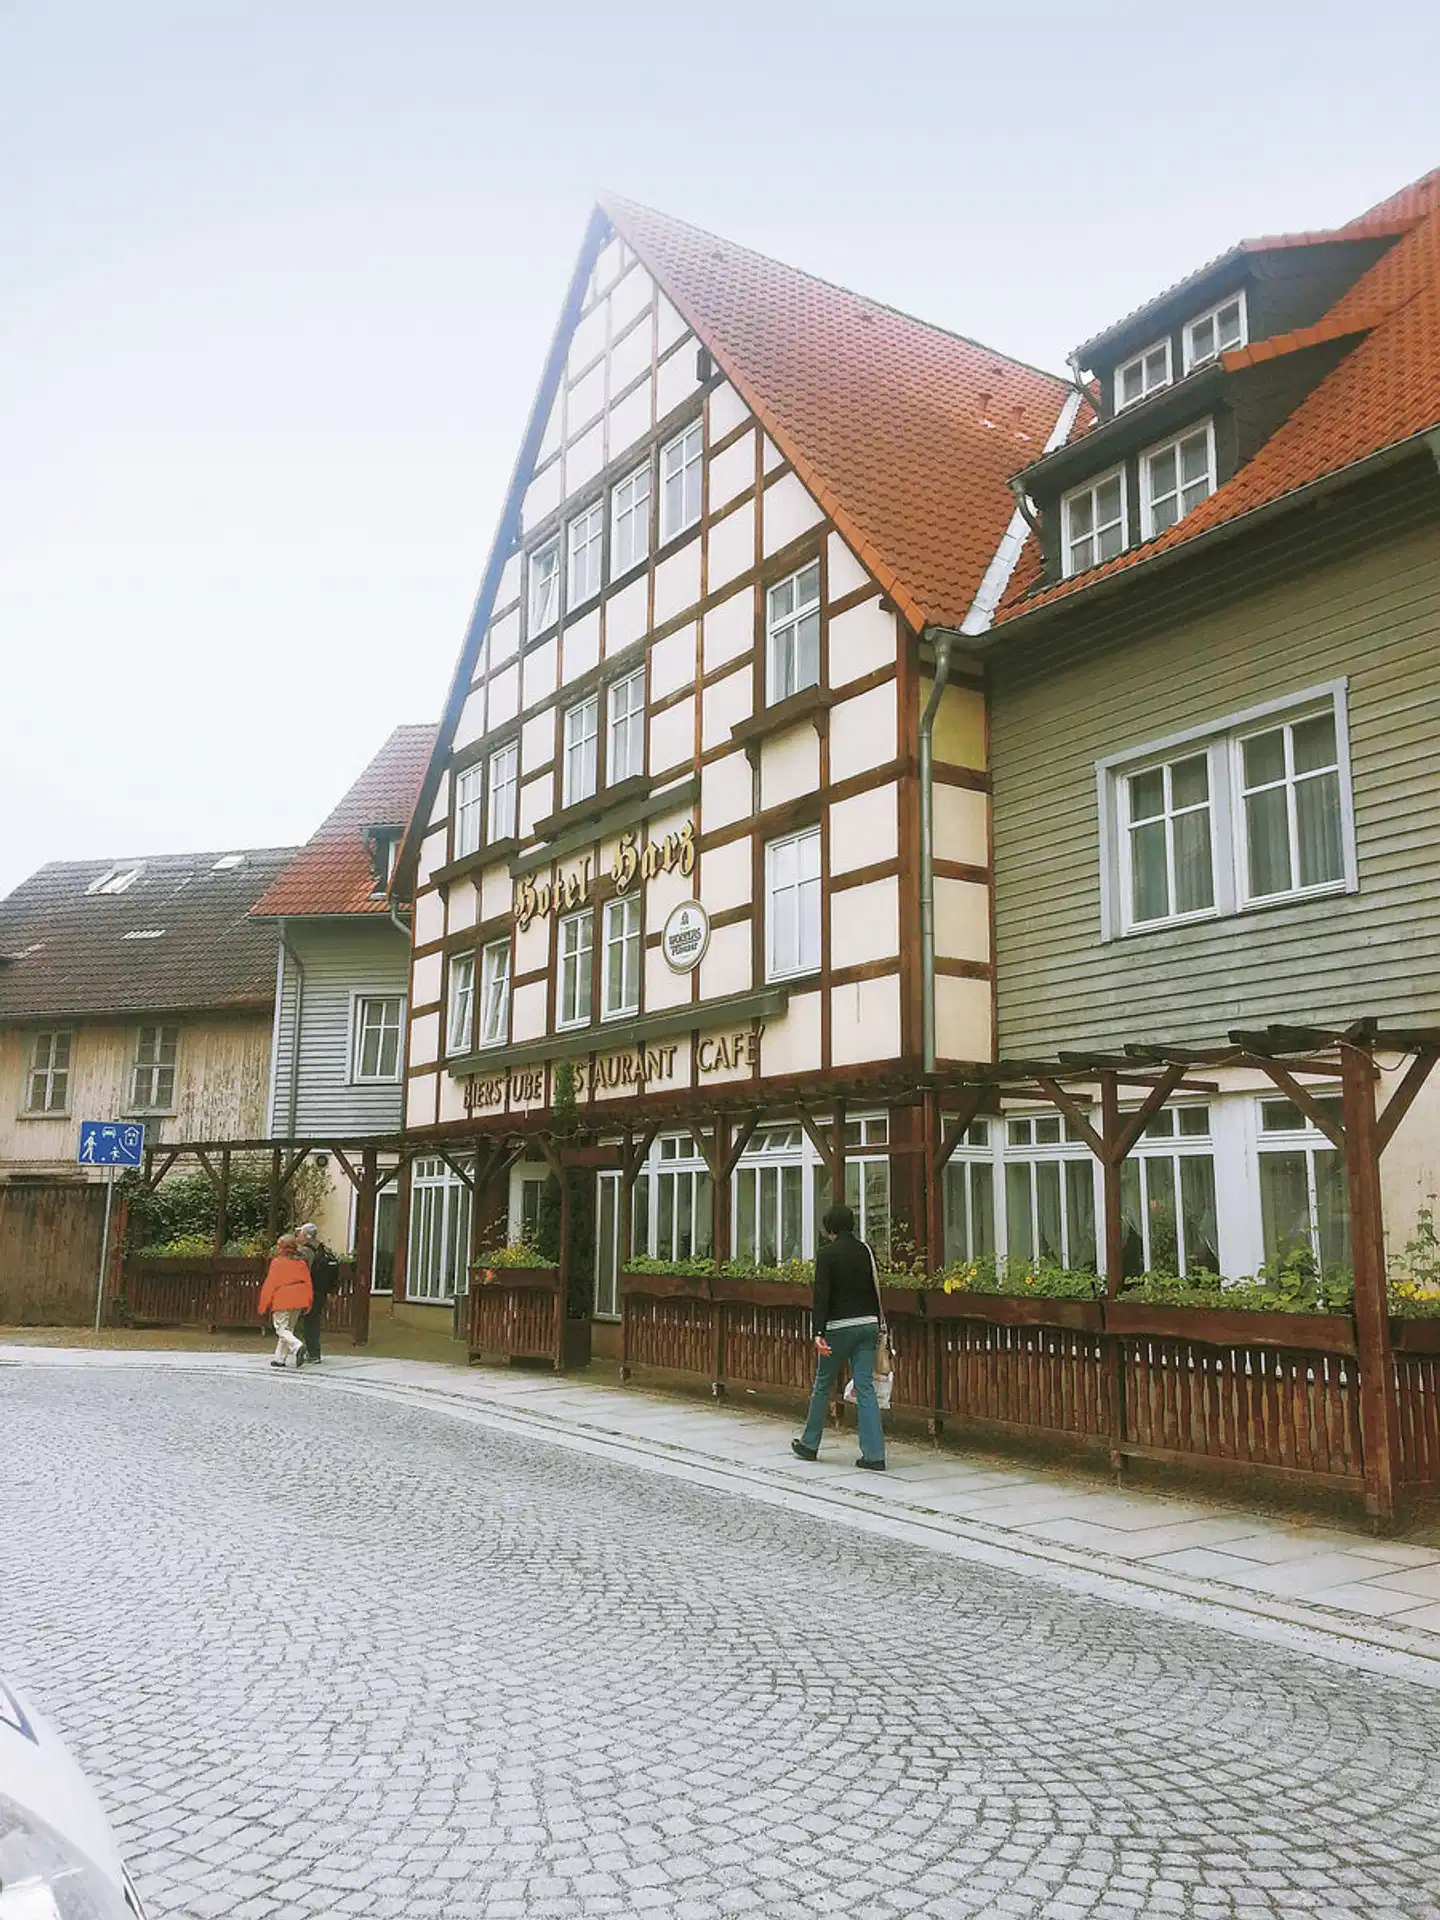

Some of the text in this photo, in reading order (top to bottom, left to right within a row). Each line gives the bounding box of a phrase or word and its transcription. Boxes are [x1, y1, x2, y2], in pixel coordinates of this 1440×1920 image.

[514, 819, 697, 933] Hotel Harz
[463, 1069, 543, 1110] BIERSTUBE
[552, 1044, 678, 1097] STAURANT
